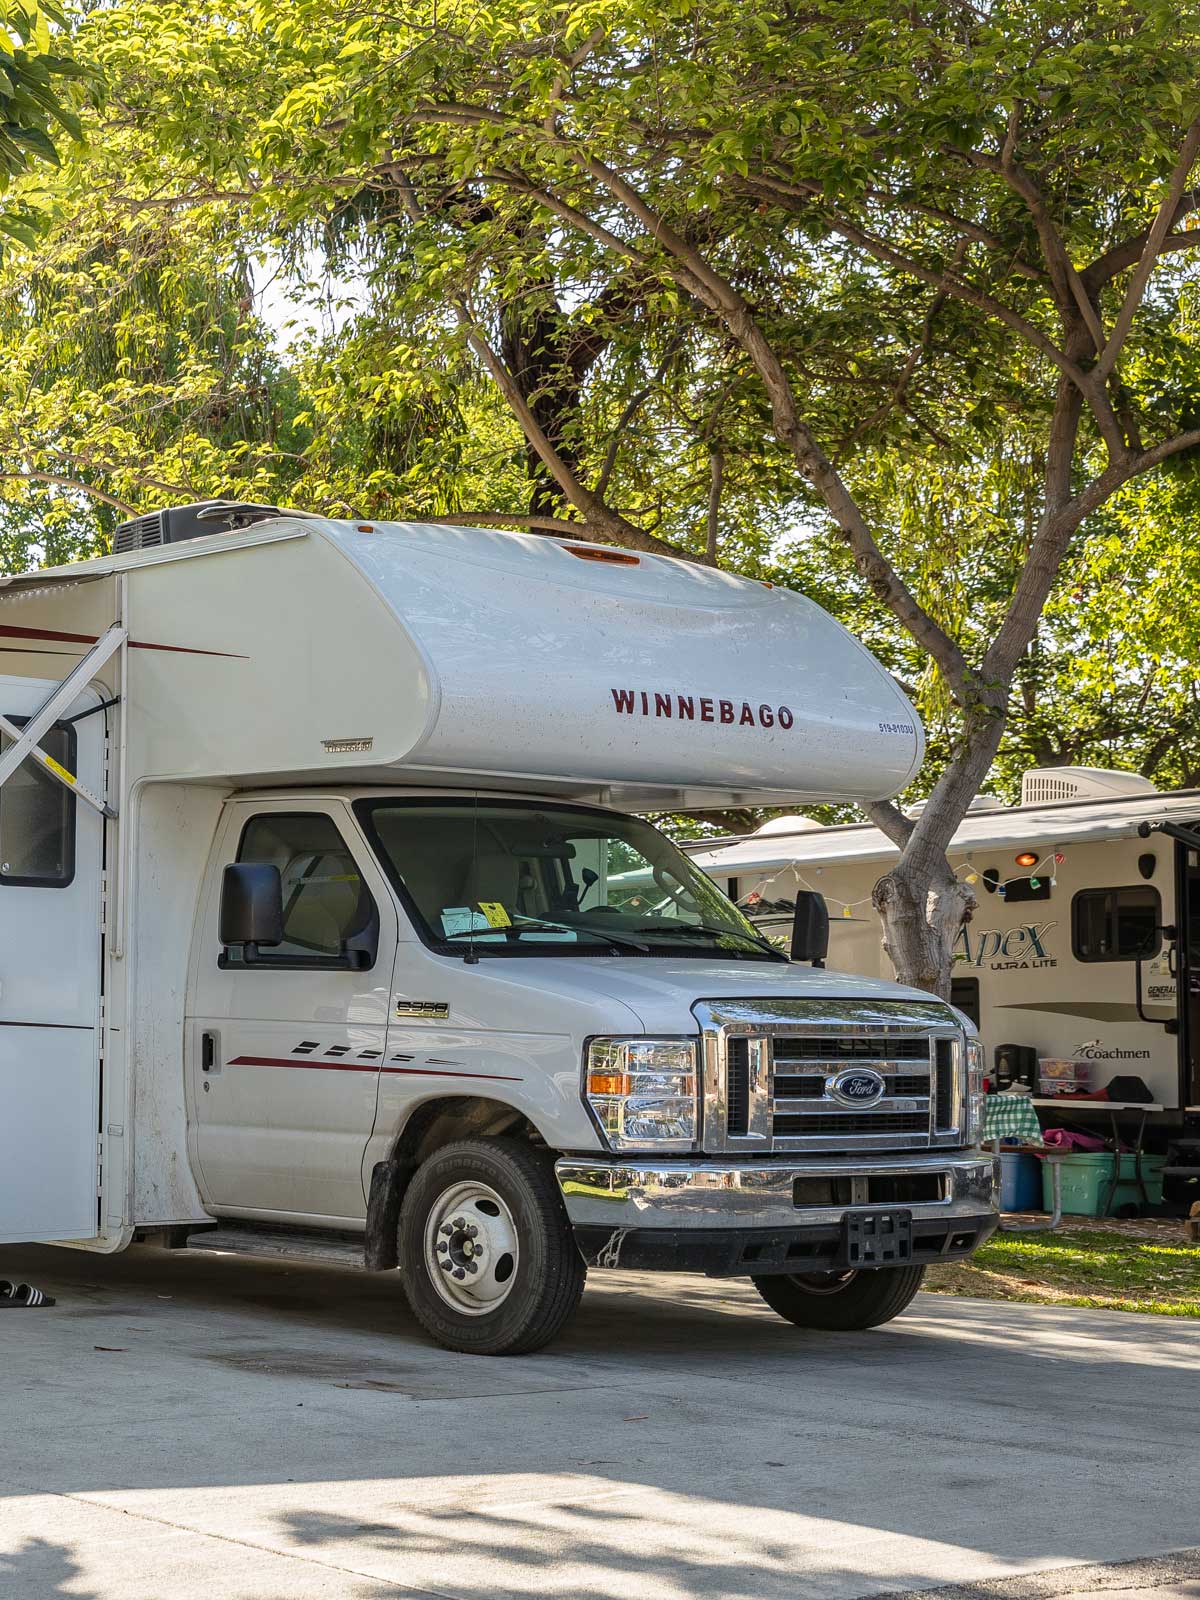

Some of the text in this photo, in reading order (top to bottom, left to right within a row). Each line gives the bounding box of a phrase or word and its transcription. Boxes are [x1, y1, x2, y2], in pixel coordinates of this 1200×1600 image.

[611, 688, 793, 729] WINNEBAGO
[991, 959, 1057, 971] ULTRA LITE
[1085, 1048, 1150, 1059] Coachmen
[849, 1078, 874, 1095] Ford
